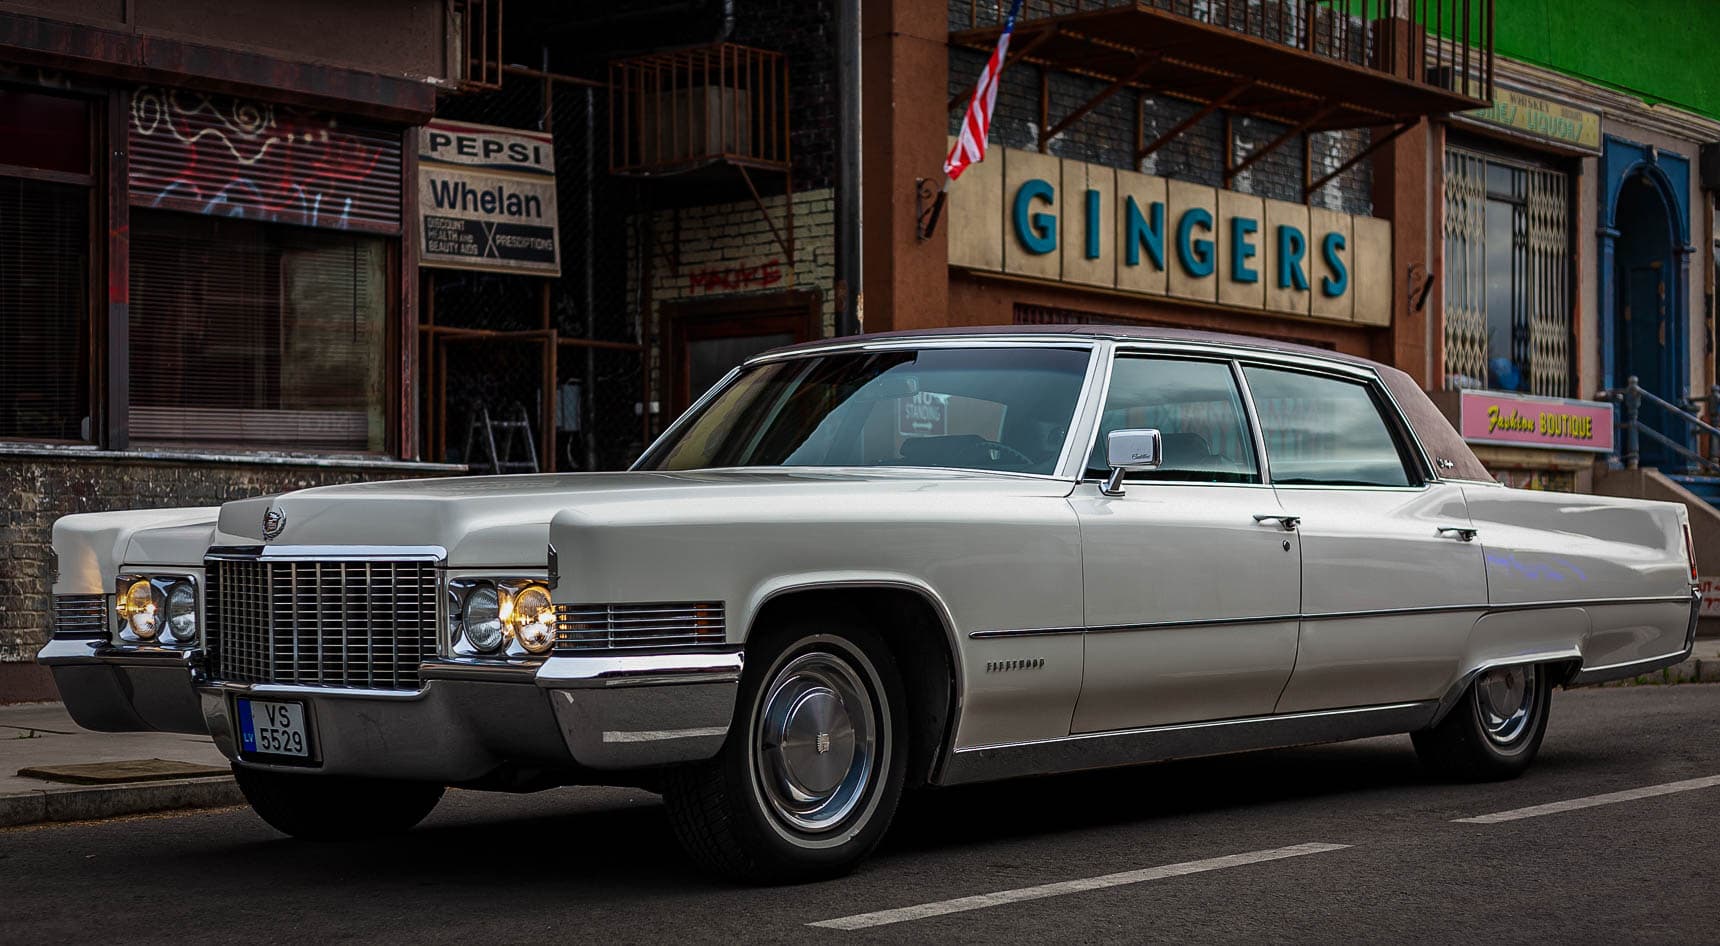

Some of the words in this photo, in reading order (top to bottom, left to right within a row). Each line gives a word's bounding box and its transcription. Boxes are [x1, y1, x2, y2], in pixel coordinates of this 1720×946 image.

[429, 132, 541, 165] PEPSI
[430, 178, 541, 219] Whelan
[427, 218, 465, 231] DISCOUNT
[427, 228, 459, 242] HEALTH
[427, 239, 460, 254] BEAUTY
[460, 243, 480, 256] AIDS
[1013, 178, 1349, 298] GINGERS
[1487, 405, 1536, 434] Fashion
[1539, 411, 1593, 440] BOUTIQUE
[986, 658, 1045, 673] FLEETWOOD
[264, 704, 291, 728] VS
[243, 732, 254, 743] LV
[260, 727, 303, 753] 5529
